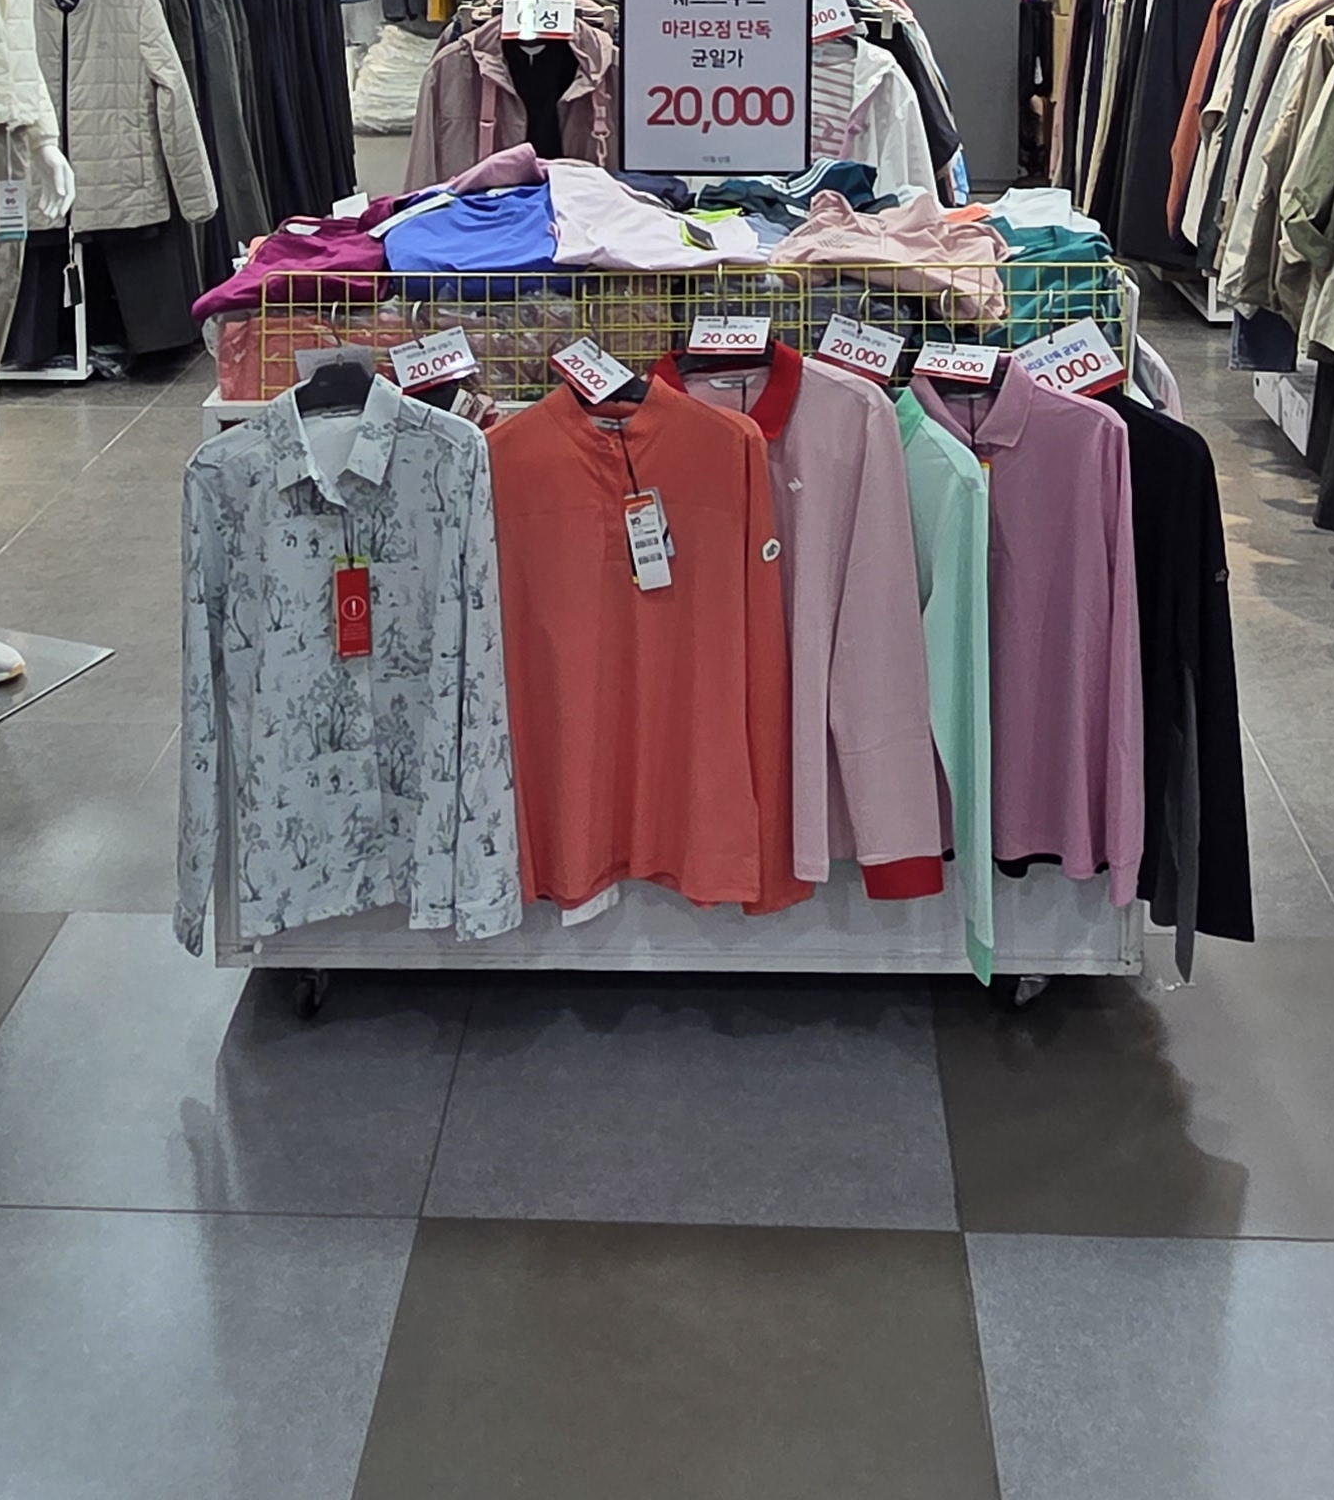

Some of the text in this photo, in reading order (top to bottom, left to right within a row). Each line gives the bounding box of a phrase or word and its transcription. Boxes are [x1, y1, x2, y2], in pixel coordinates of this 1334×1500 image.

[662, 19, 772, 39] 마리오점 단독
[690, 48, 744, 69] 균일가
[646, 85, 795, 134] 20,000
[700, 332, 758, 345] 20,000
[829, 338, 887, 368] 20,000
[562, 353, 608, 390] 20,000
[926, 356, 984, 373] 20,000
